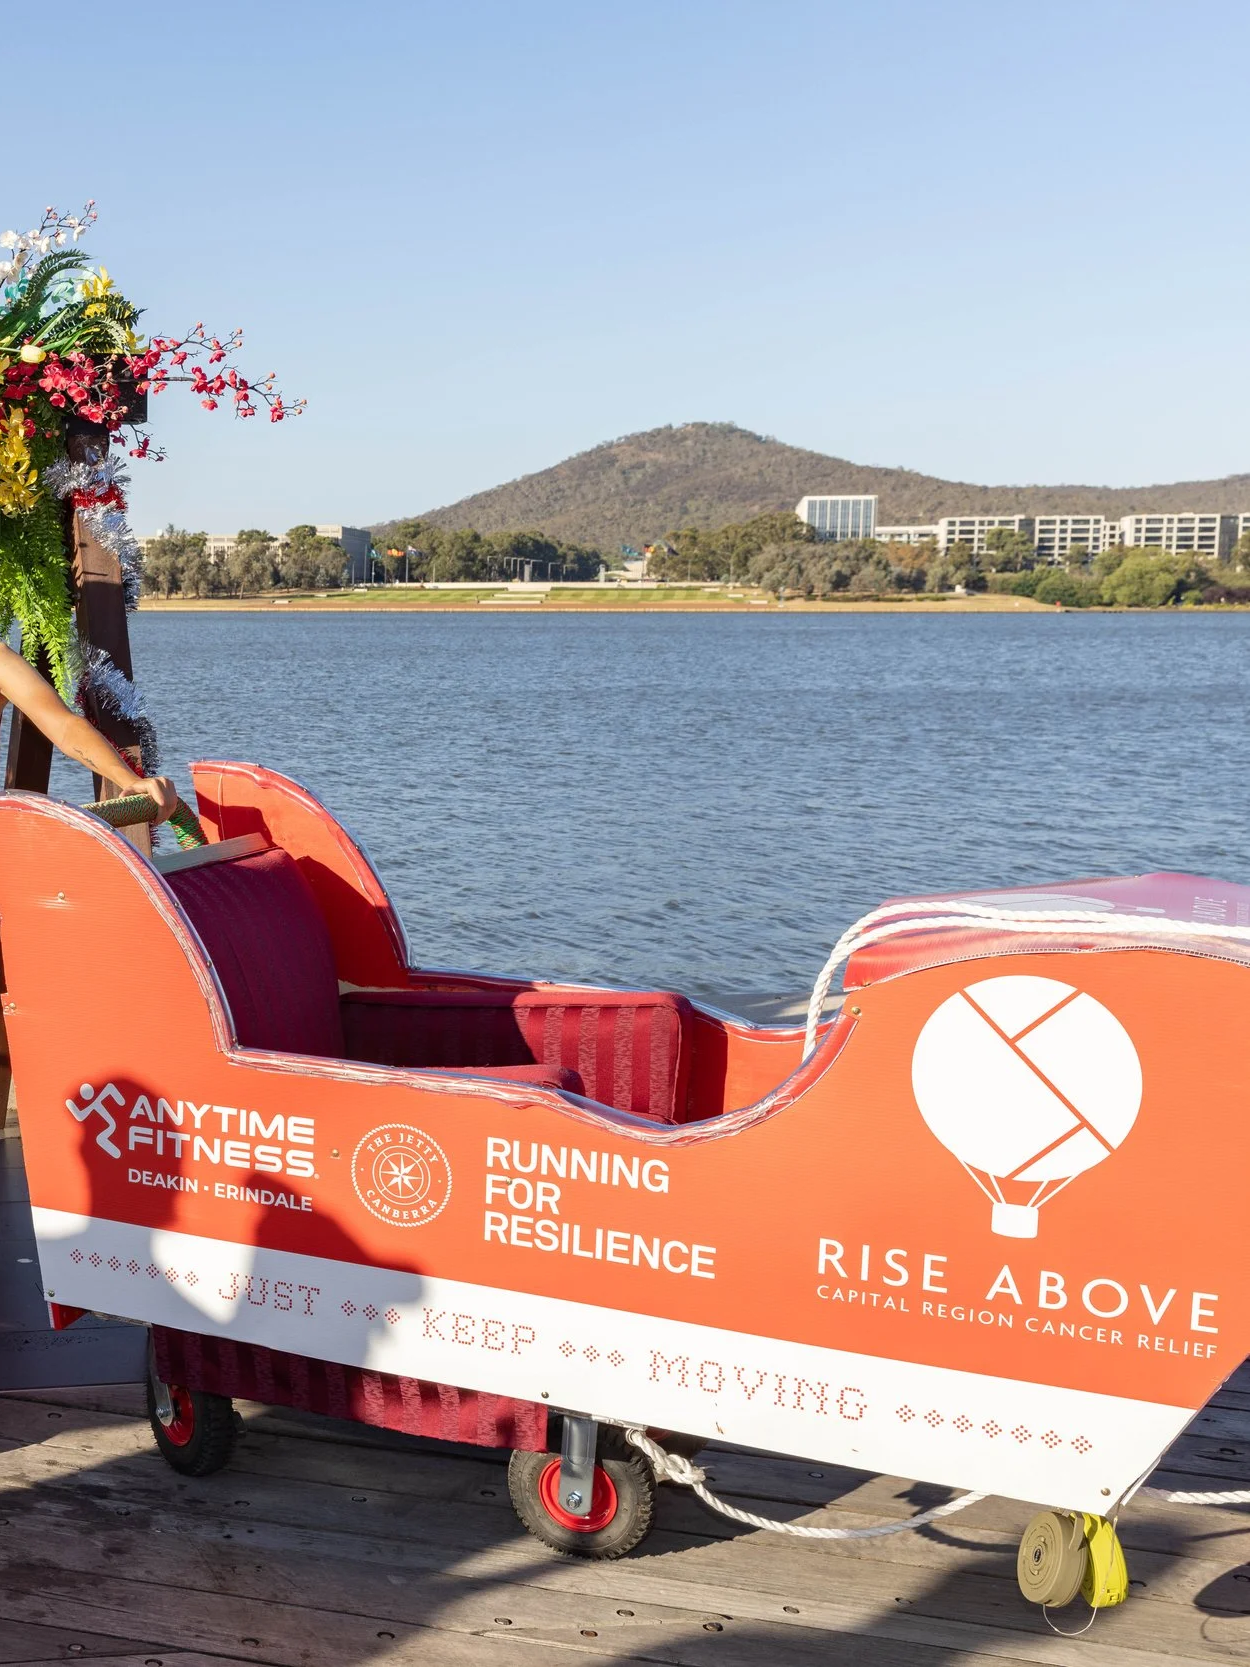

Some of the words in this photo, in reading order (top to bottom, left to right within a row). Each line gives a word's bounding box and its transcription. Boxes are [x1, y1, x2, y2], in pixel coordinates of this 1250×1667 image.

[129, 1094, 315, 1145] ANYTIME
[367, 1133, 392, 1152] THE
[399, 1133, 439, 1162] JETTY
[486, 1136, 670, 1194] RUNNING
[128, 1168, 199, 1194] DEAKIN
[214, 1182, 313, 1212] ERINDALE
[366, 1189, 438, 1220] CANBERRA
[485, 1173, 561, 1215] FOR
[484, 1210, 717, 1280] RESILIENCE
[817, 1237, 949, 1294] RISE
[985, 1264, 1220, 1334] ABOVE
[218, 1272, 320, 1316] JUST
[421, 1306, 536, 1355] KEEP
[648, 1349, 868, 1422] MOVING
[816, 1284, 910, 1313] CAPITAL
[922, 1301, 1014, 1329] REGION
[1025, 1317, 1124, 1346] CANCER
[1137, 1334, 1218, 1359] RELIEF
